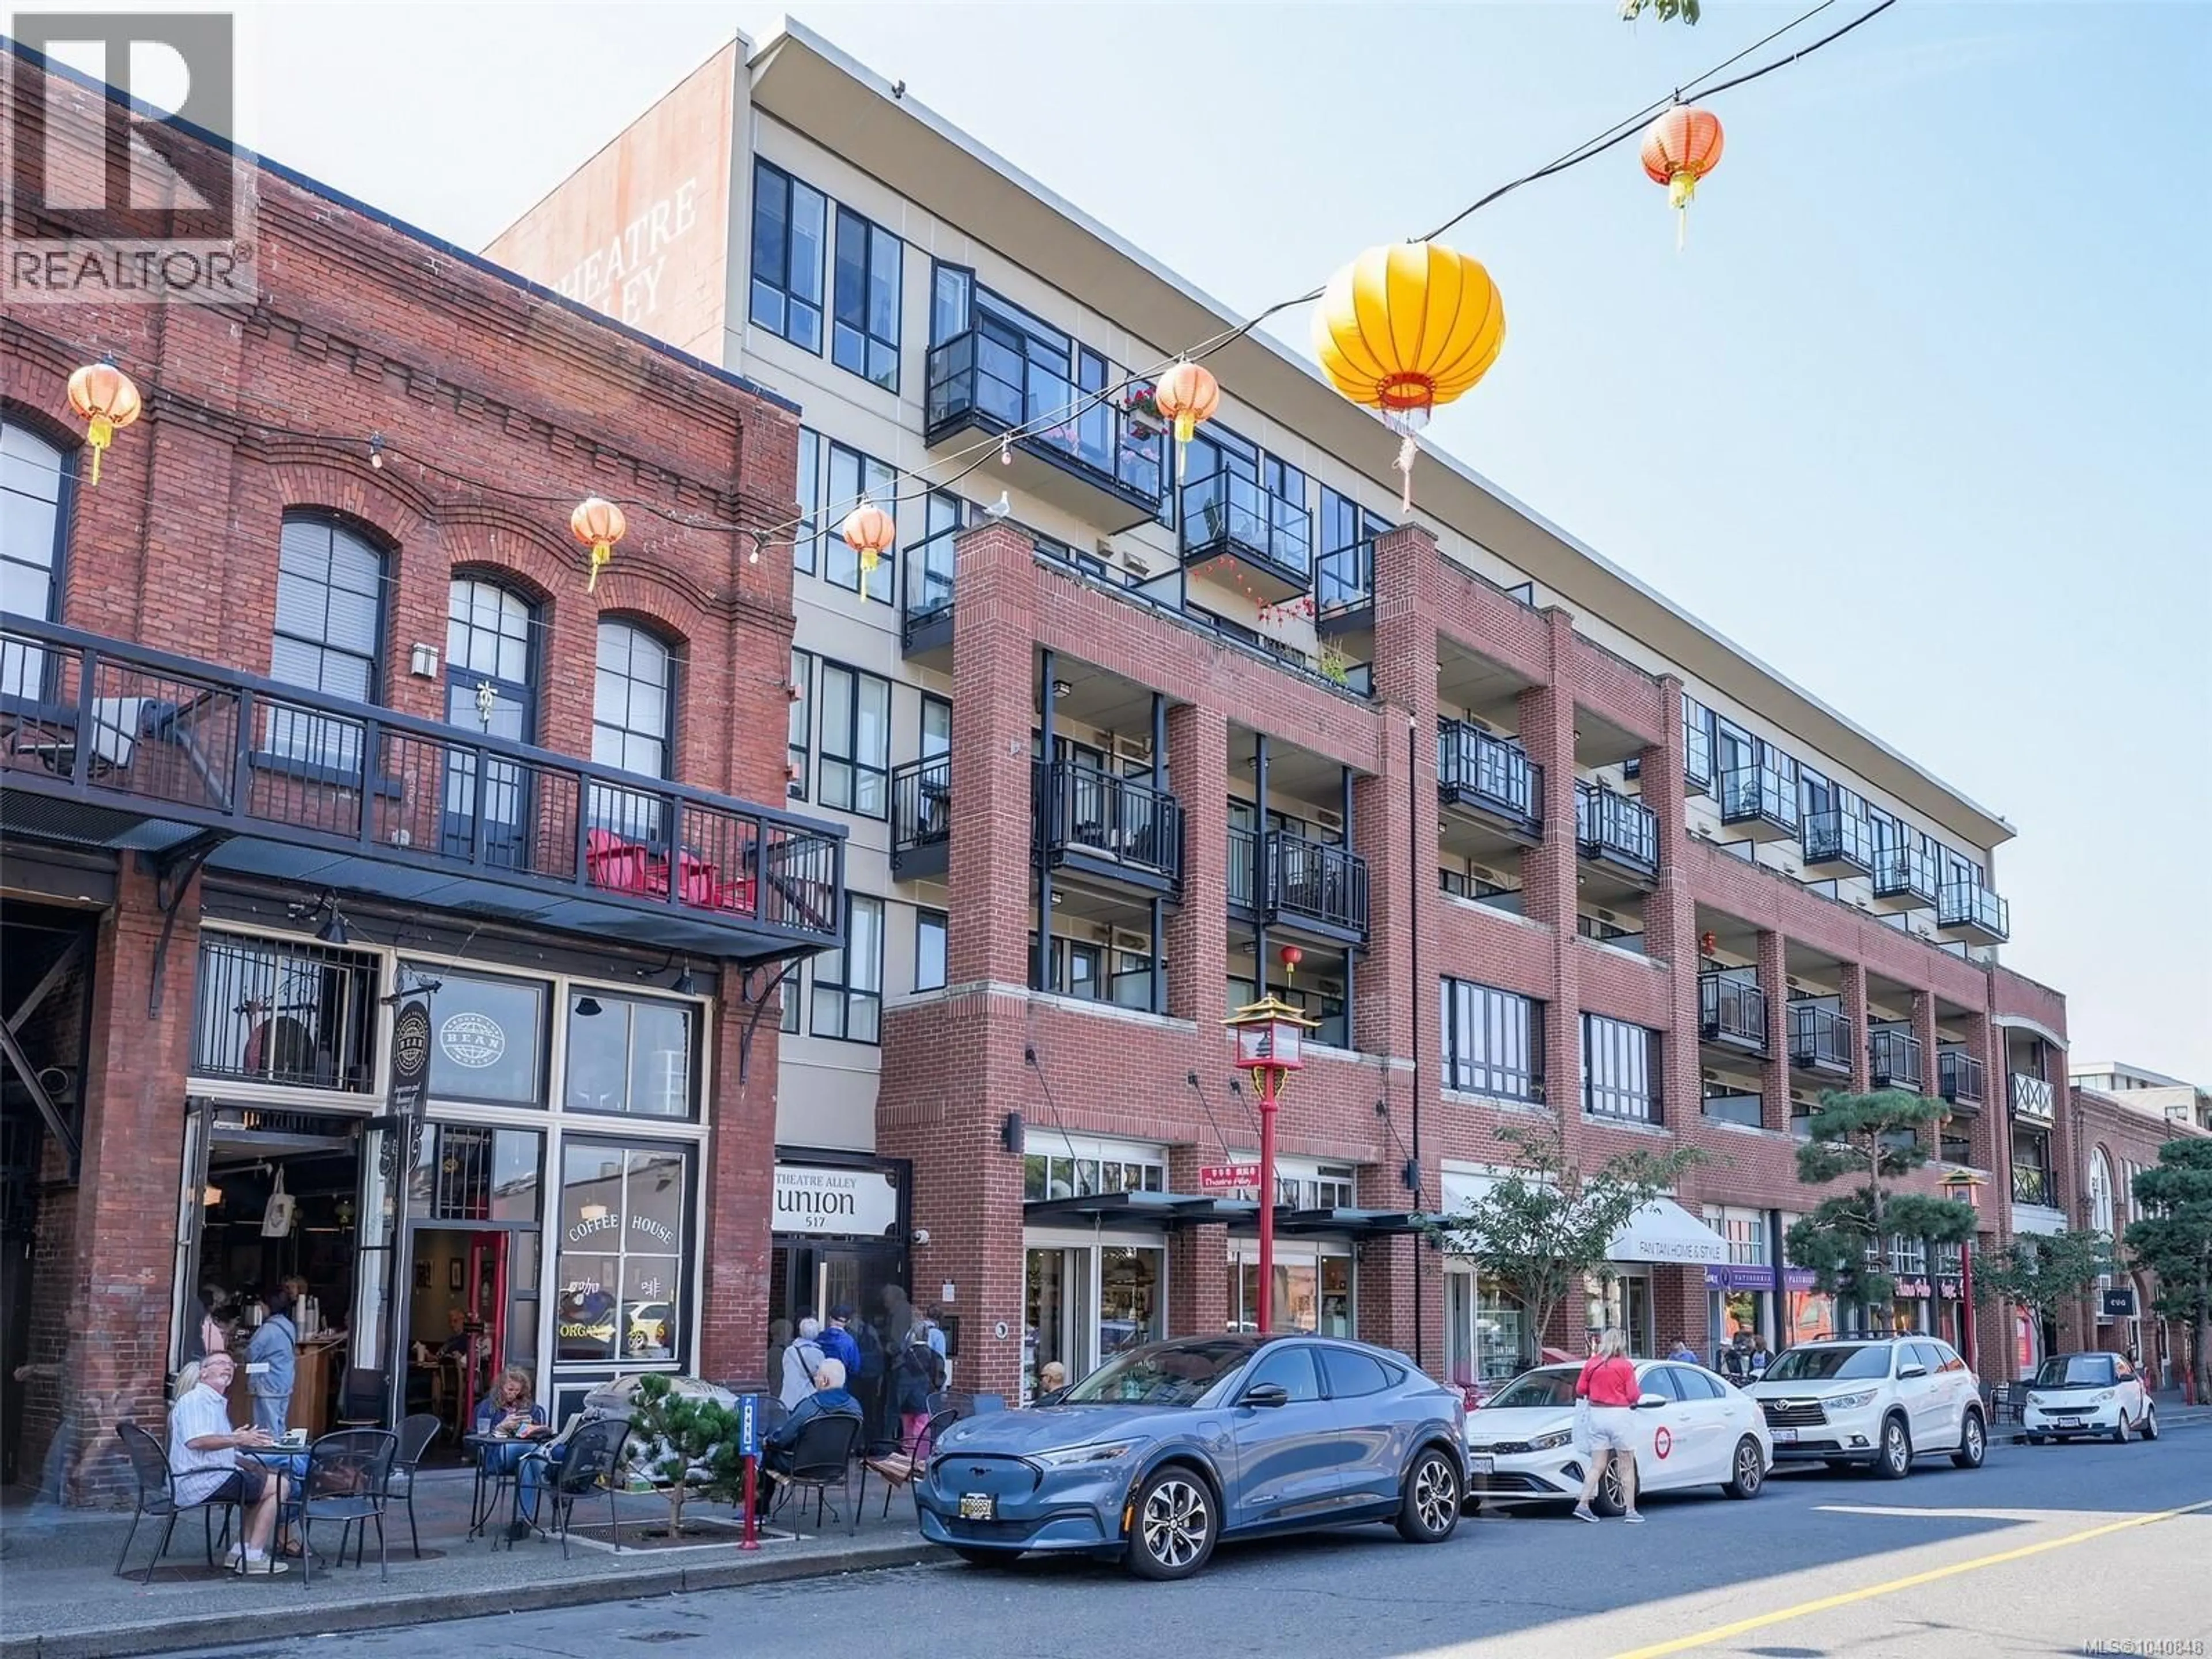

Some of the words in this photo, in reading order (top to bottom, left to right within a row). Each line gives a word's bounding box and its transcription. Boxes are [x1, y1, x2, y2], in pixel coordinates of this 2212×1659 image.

[446, 1033, 499, 1048] BEAN
[776, 1172, 824, 1187] THEATRE
[825, 1177, 857, 1189] ALLEY
[569, 1214, 619, 1243] COFFEE
[631, 1215, 674, 1244] HOUSE
[805, 1216, 825, 1228] 517
